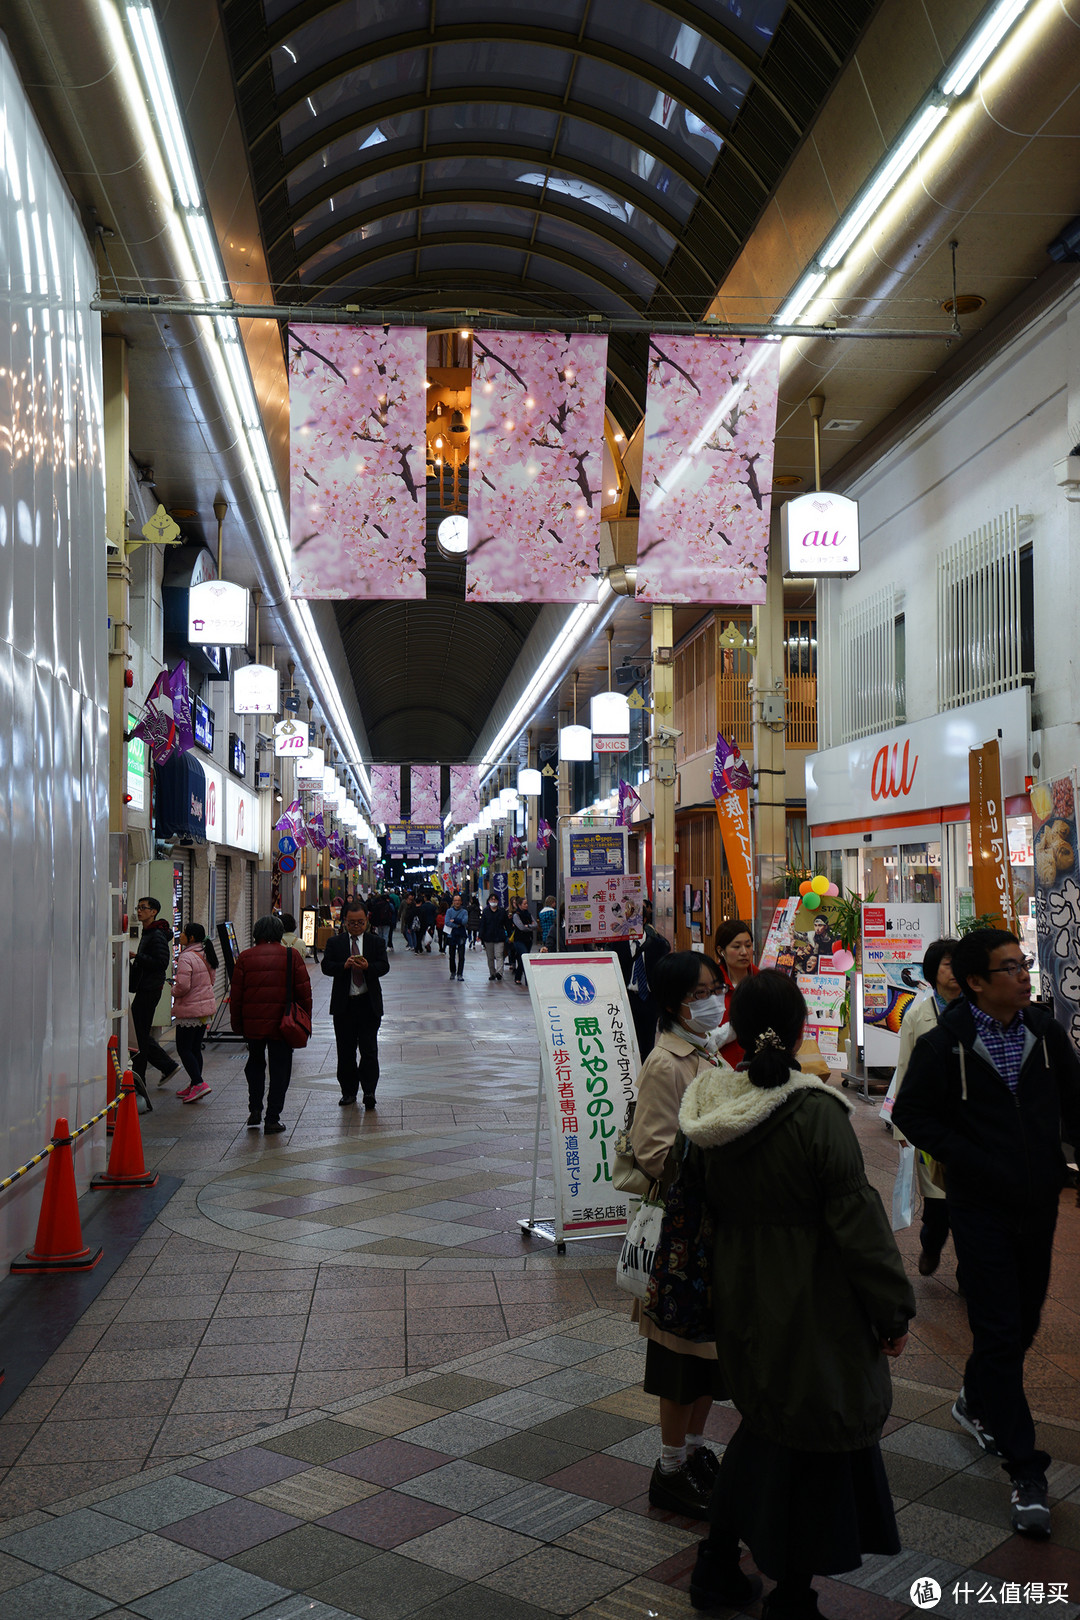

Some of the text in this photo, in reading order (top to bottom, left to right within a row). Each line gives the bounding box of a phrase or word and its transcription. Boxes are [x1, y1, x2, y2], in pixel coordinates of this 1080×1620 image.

[802, 530, 847, 547] au
[279, 735, 305, 750] JTB
[605, 741, 626, 750] KICS
[871, 738, 918, 801] au
[896, 918, 920, 931] iPad
[868, 951, 884, 959] MNP
[607, 1003, 634, 1101] みんなで守ろう
[547, 1005, 581, 1198] ここは歩行者専用道路です
[574, 1016, 616, 1183] 思いやりのルール
[572, 1205, 627, 1221] 三条名店街
